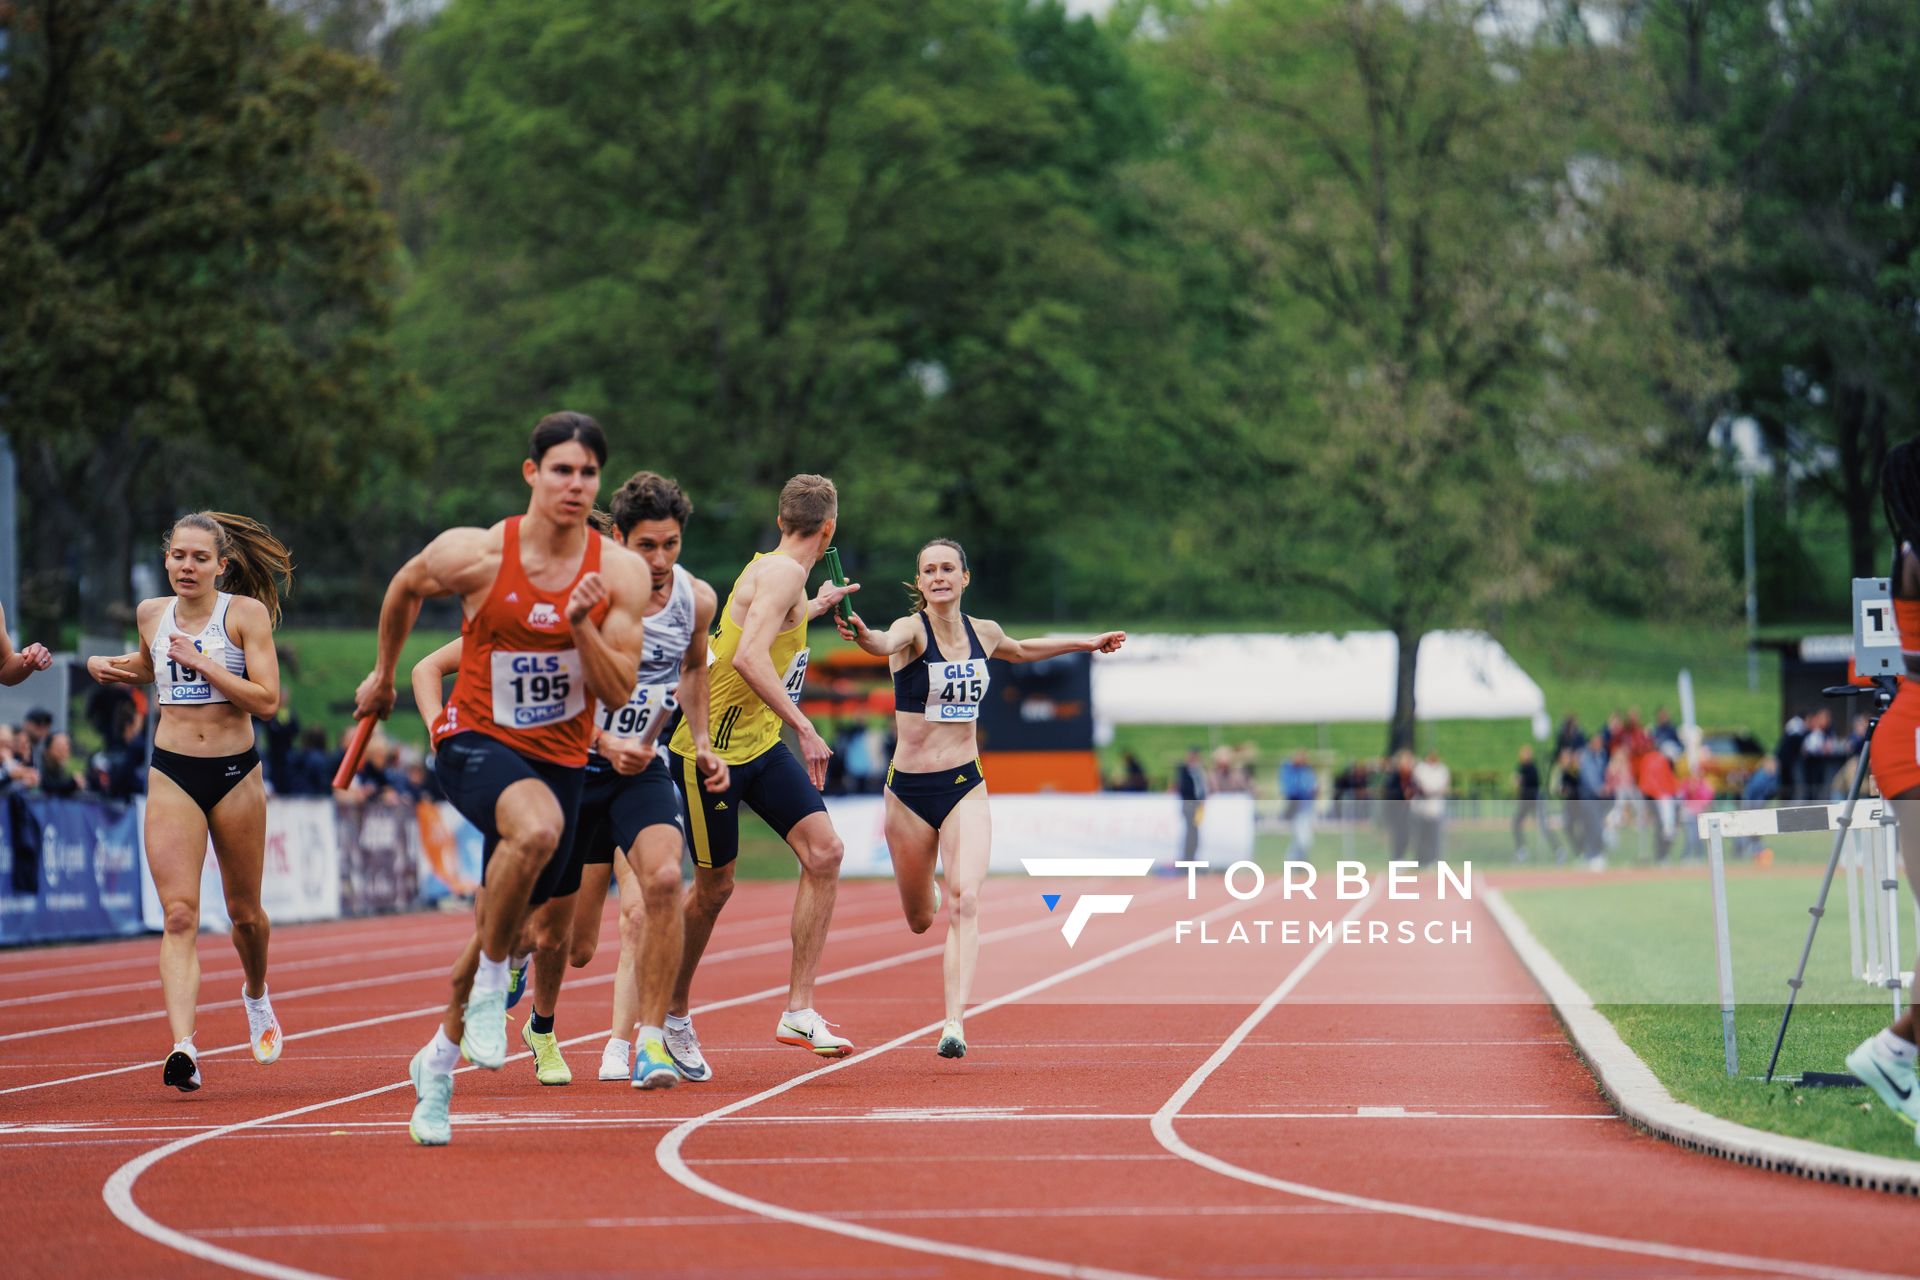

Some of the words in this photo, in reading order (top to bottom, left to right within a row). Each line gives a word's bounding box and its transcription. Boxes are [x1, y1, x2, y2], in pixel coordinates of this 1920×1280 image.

[167, 660, 206, 683] 19
[785, 669, 804, 690] 41
[186, 687, 209, 695] PLAN
[509, 673, 570, 705] 195
[940, 679, 982, 703] 415
[603, 707, 651, 733] 196
